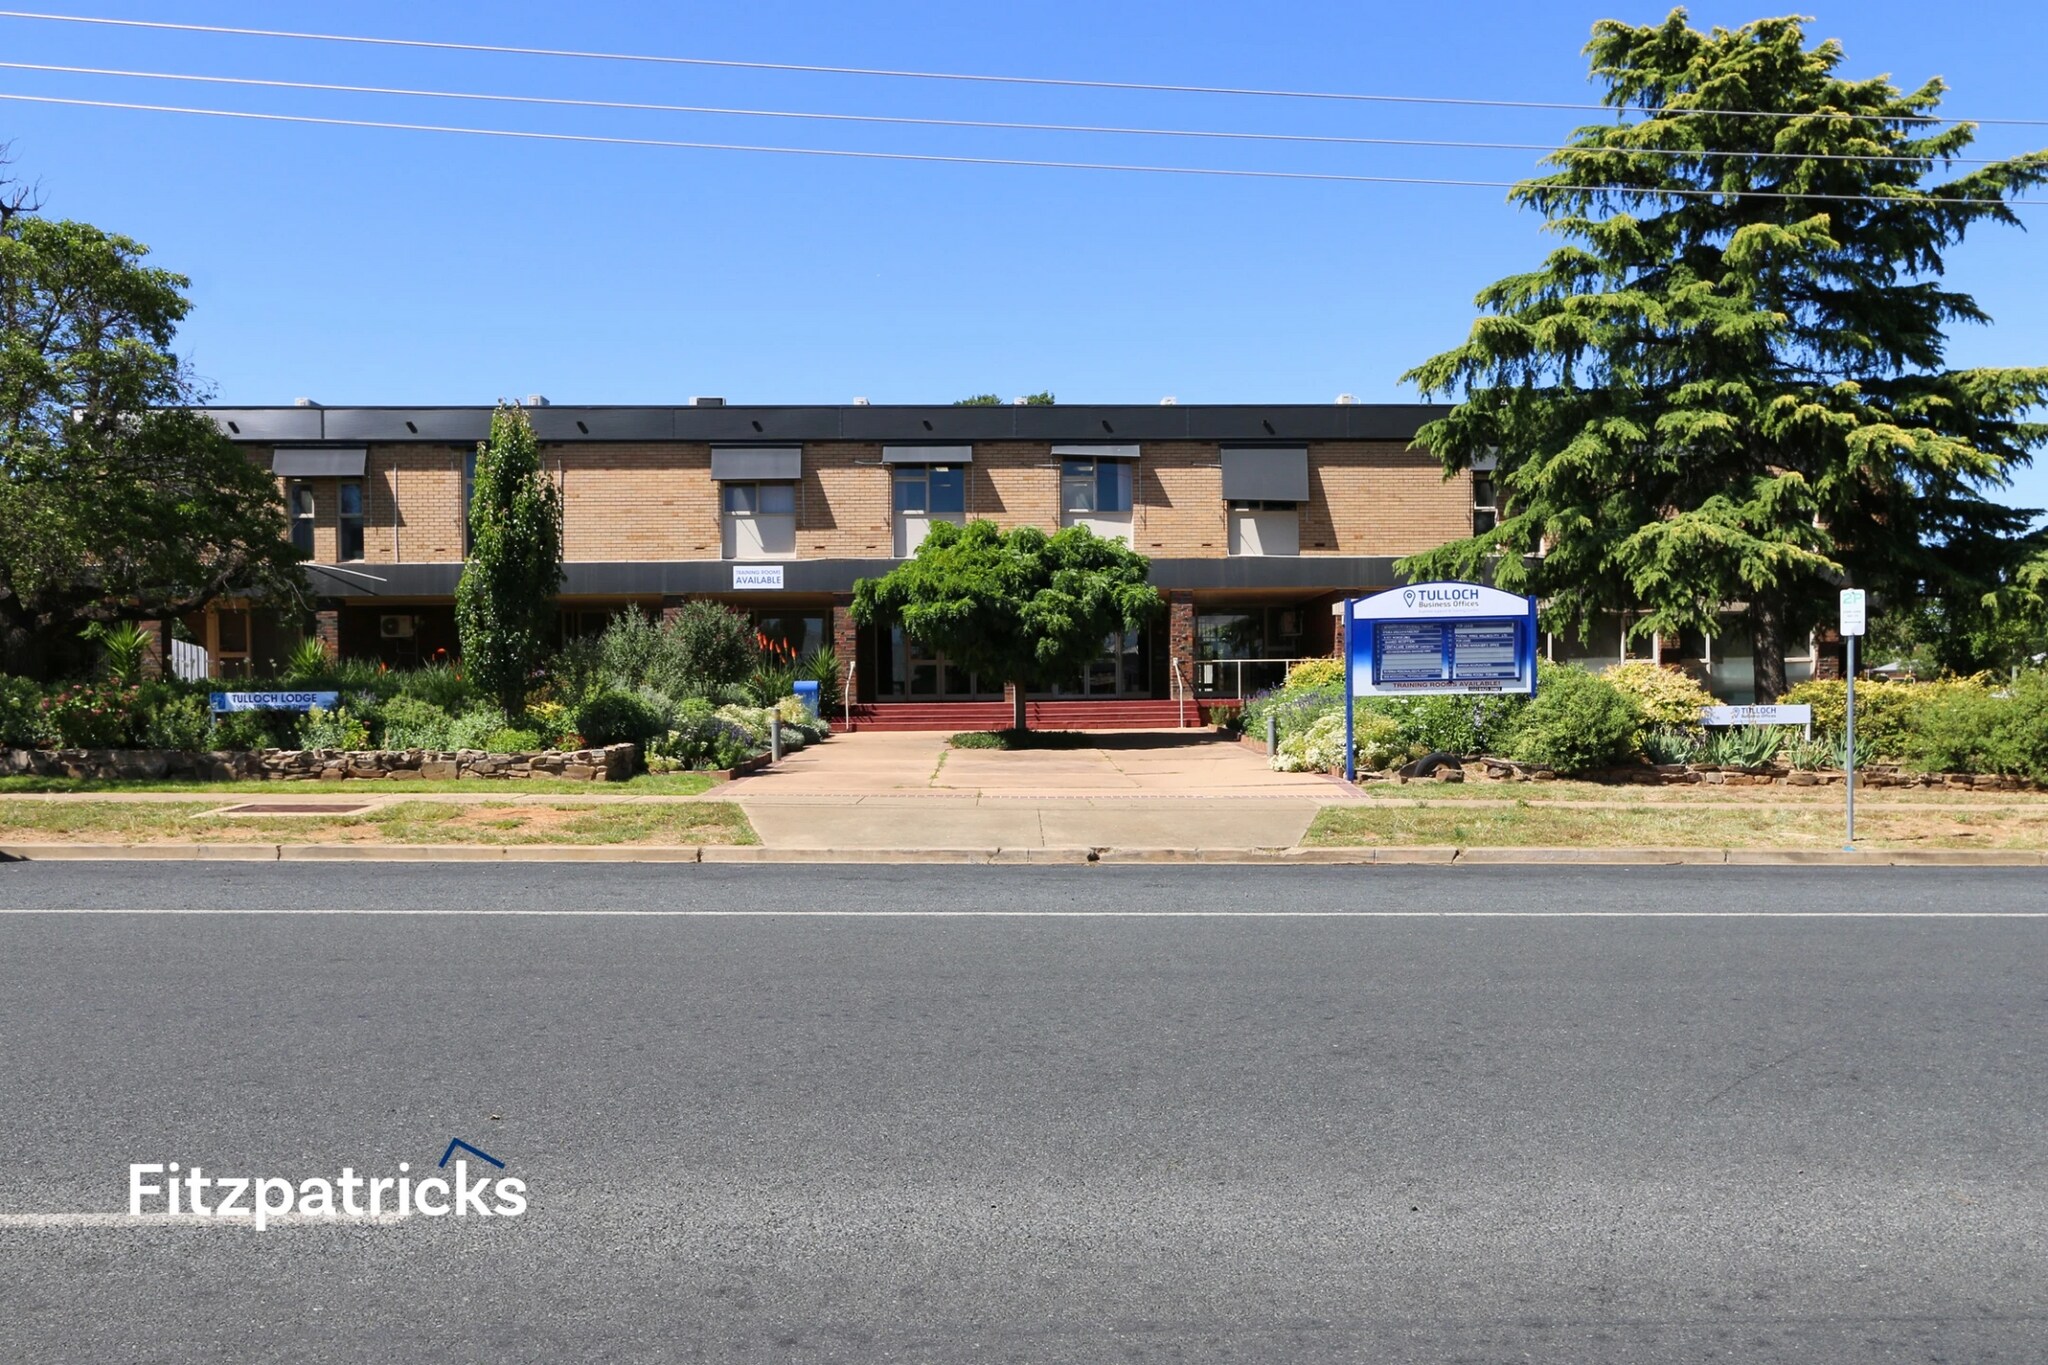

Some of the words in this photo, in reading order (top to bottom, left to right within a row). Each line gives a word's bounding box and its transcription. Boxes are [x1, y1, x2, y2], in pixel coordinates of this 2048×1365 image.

[736, 576, 781, 584] AVAILABLE
[1418, 589, 1479, 601] TULLOCH
[1843, 593, 1862, 604] 2P
[232, 693, 278, 703] TULLOCH
[281, 693, 317, 703] LODGE
